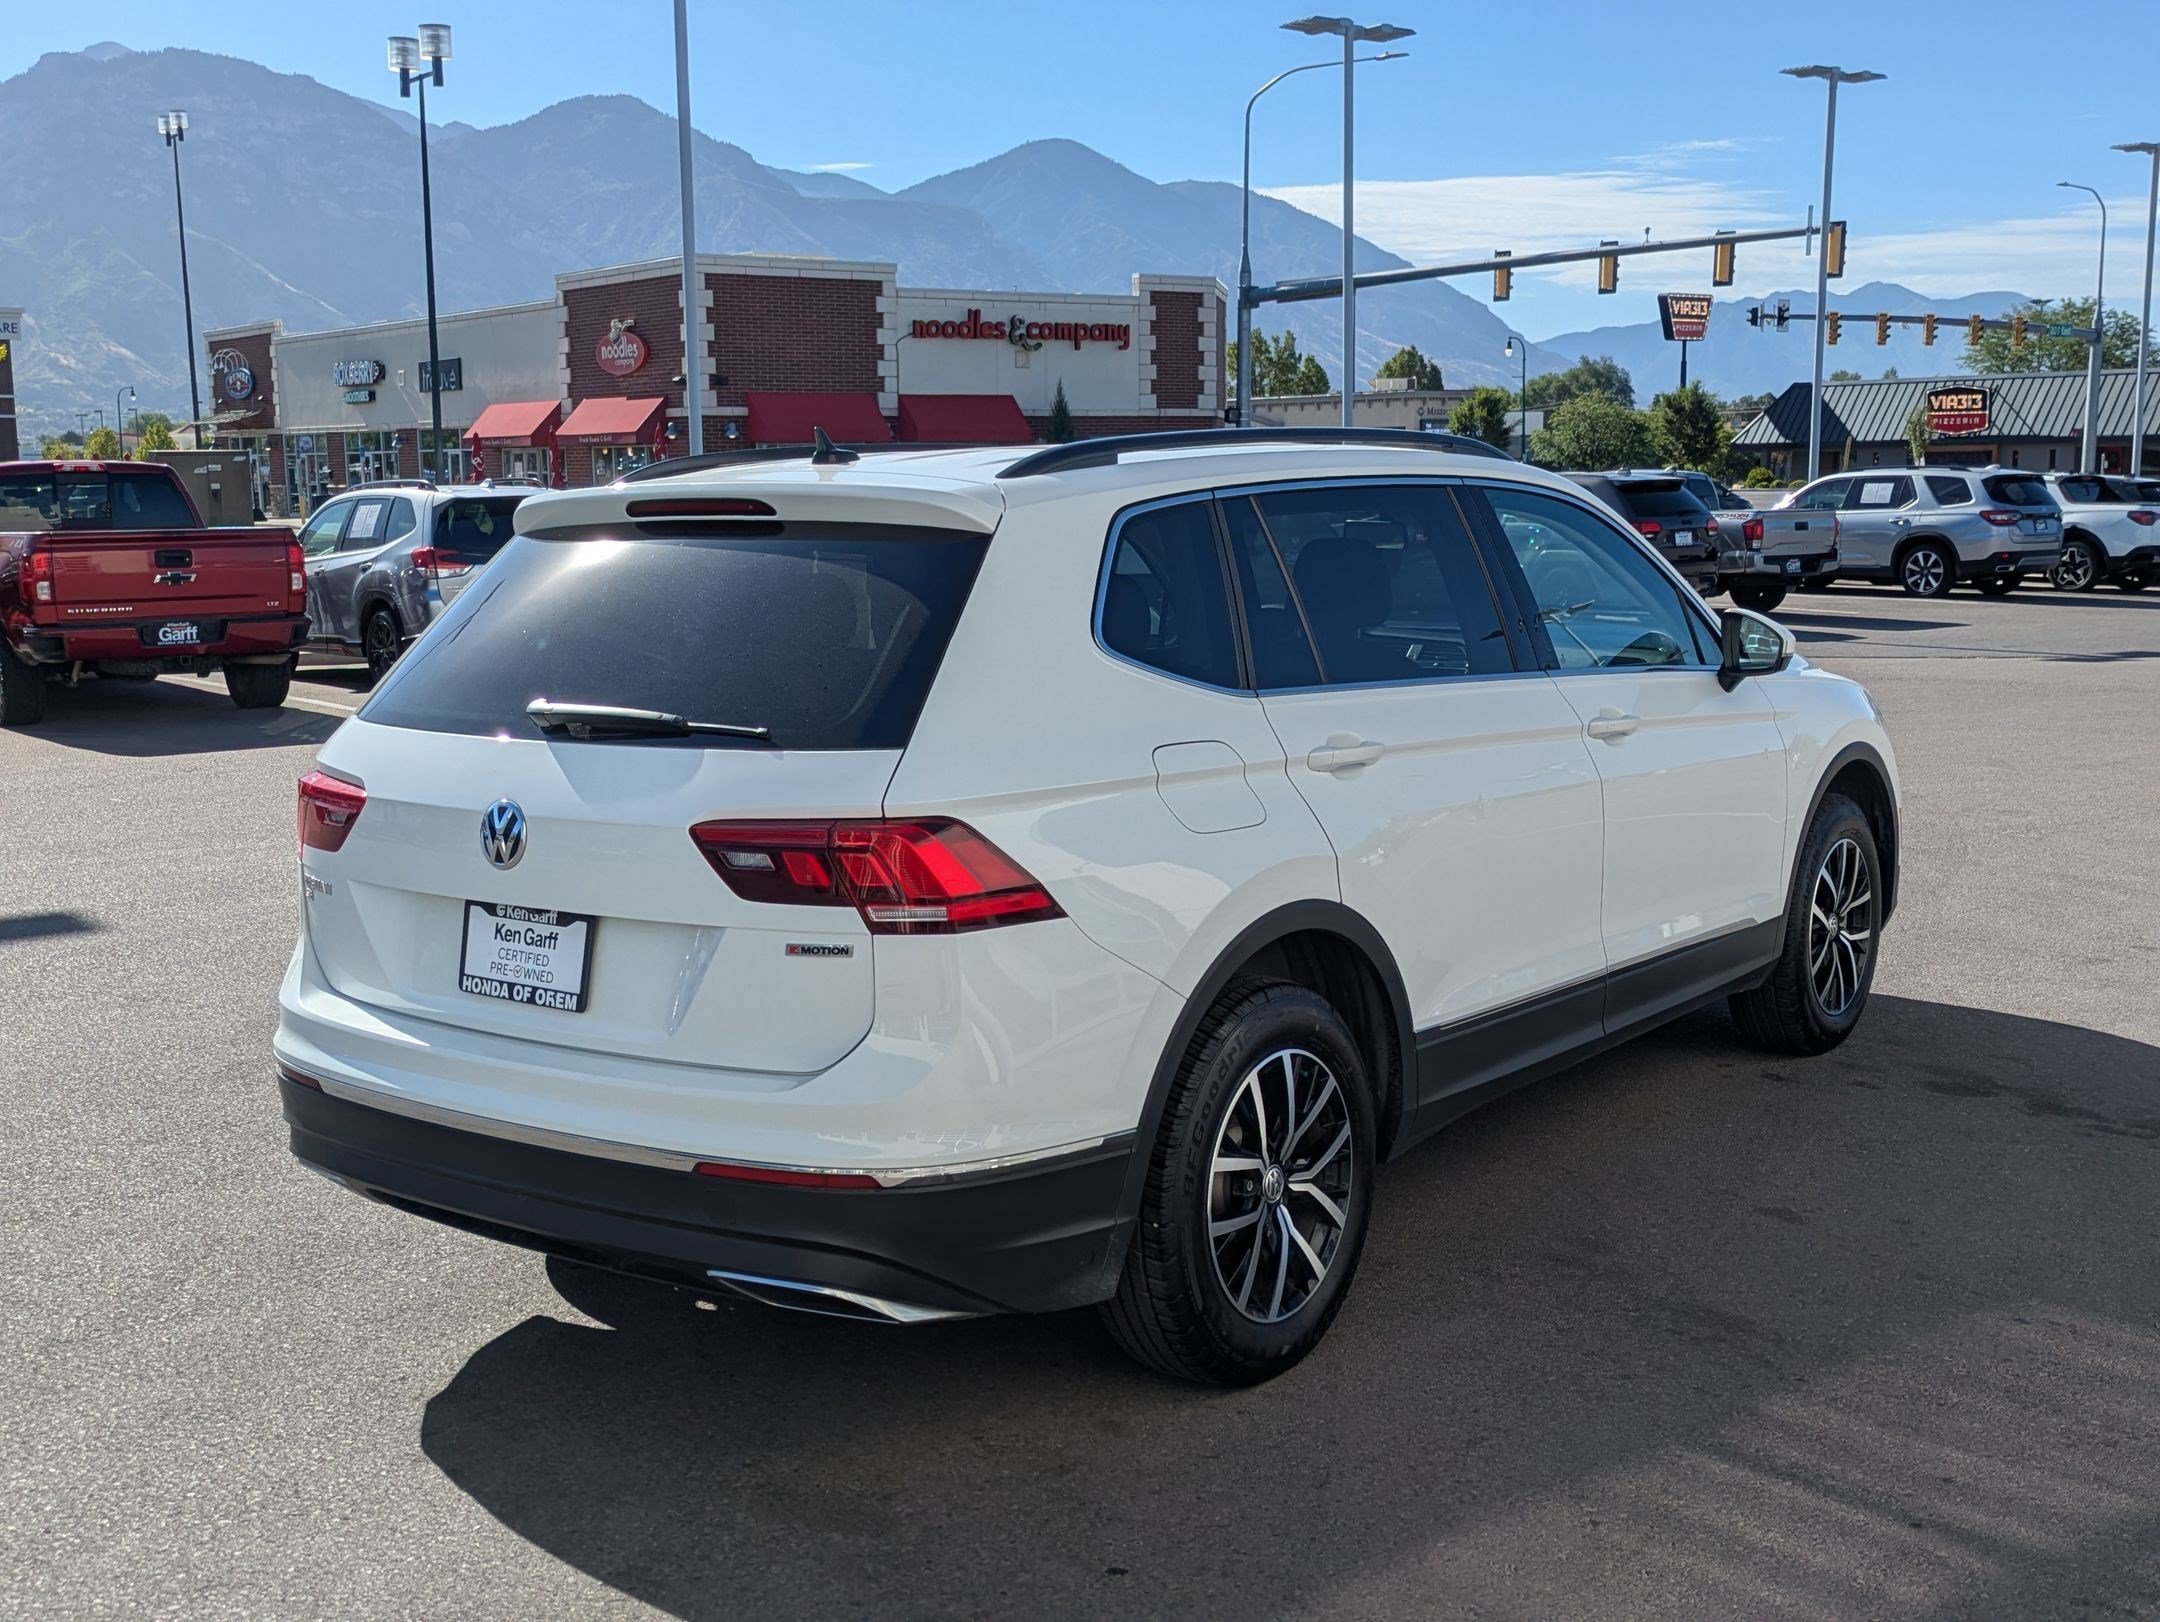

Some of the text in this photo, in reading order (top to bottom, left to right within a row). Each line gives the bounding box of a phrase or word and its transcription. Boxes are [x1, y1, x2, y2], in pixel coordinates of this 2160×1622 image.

[912, 308, 1006, 340] noodles
[1026, 321, 1130, 350] company
[601, 335, 639, 360] noodles
[1932, 417, 1980, 425] PIZZERIA
[158, 626, 198, 642] Garff
[506, 904, 529, 921] Ken
[494, 922, 559, 950] Ken Garff
[498, 947, 550, 967] CERTIFIED
[489, 961, 554, 984] PRE-OWNED
[462, 975, 578, 1011] HONDA OF OREM
